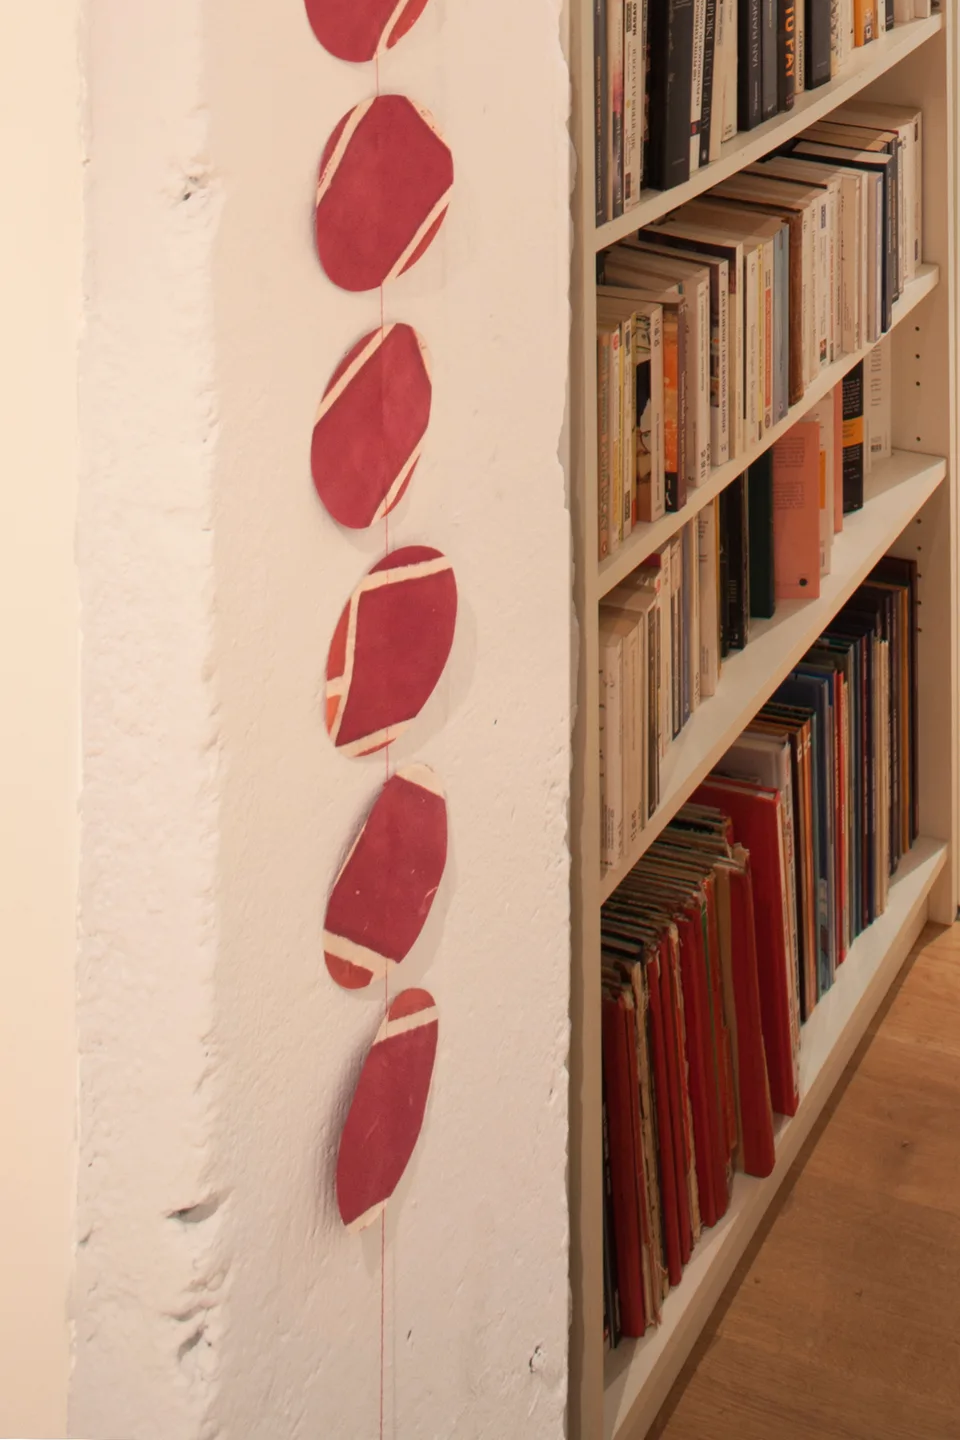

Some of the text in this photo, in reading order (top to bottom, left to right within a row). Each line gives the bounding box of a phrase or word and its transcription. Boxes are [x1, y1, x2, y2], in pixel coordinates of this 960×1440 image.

[785, 6, 794, 32] TO
[704, 49, 713, 86] BECH
[784, 37, 795, 78] PAY
[702, 106, 712, 132] BAY
